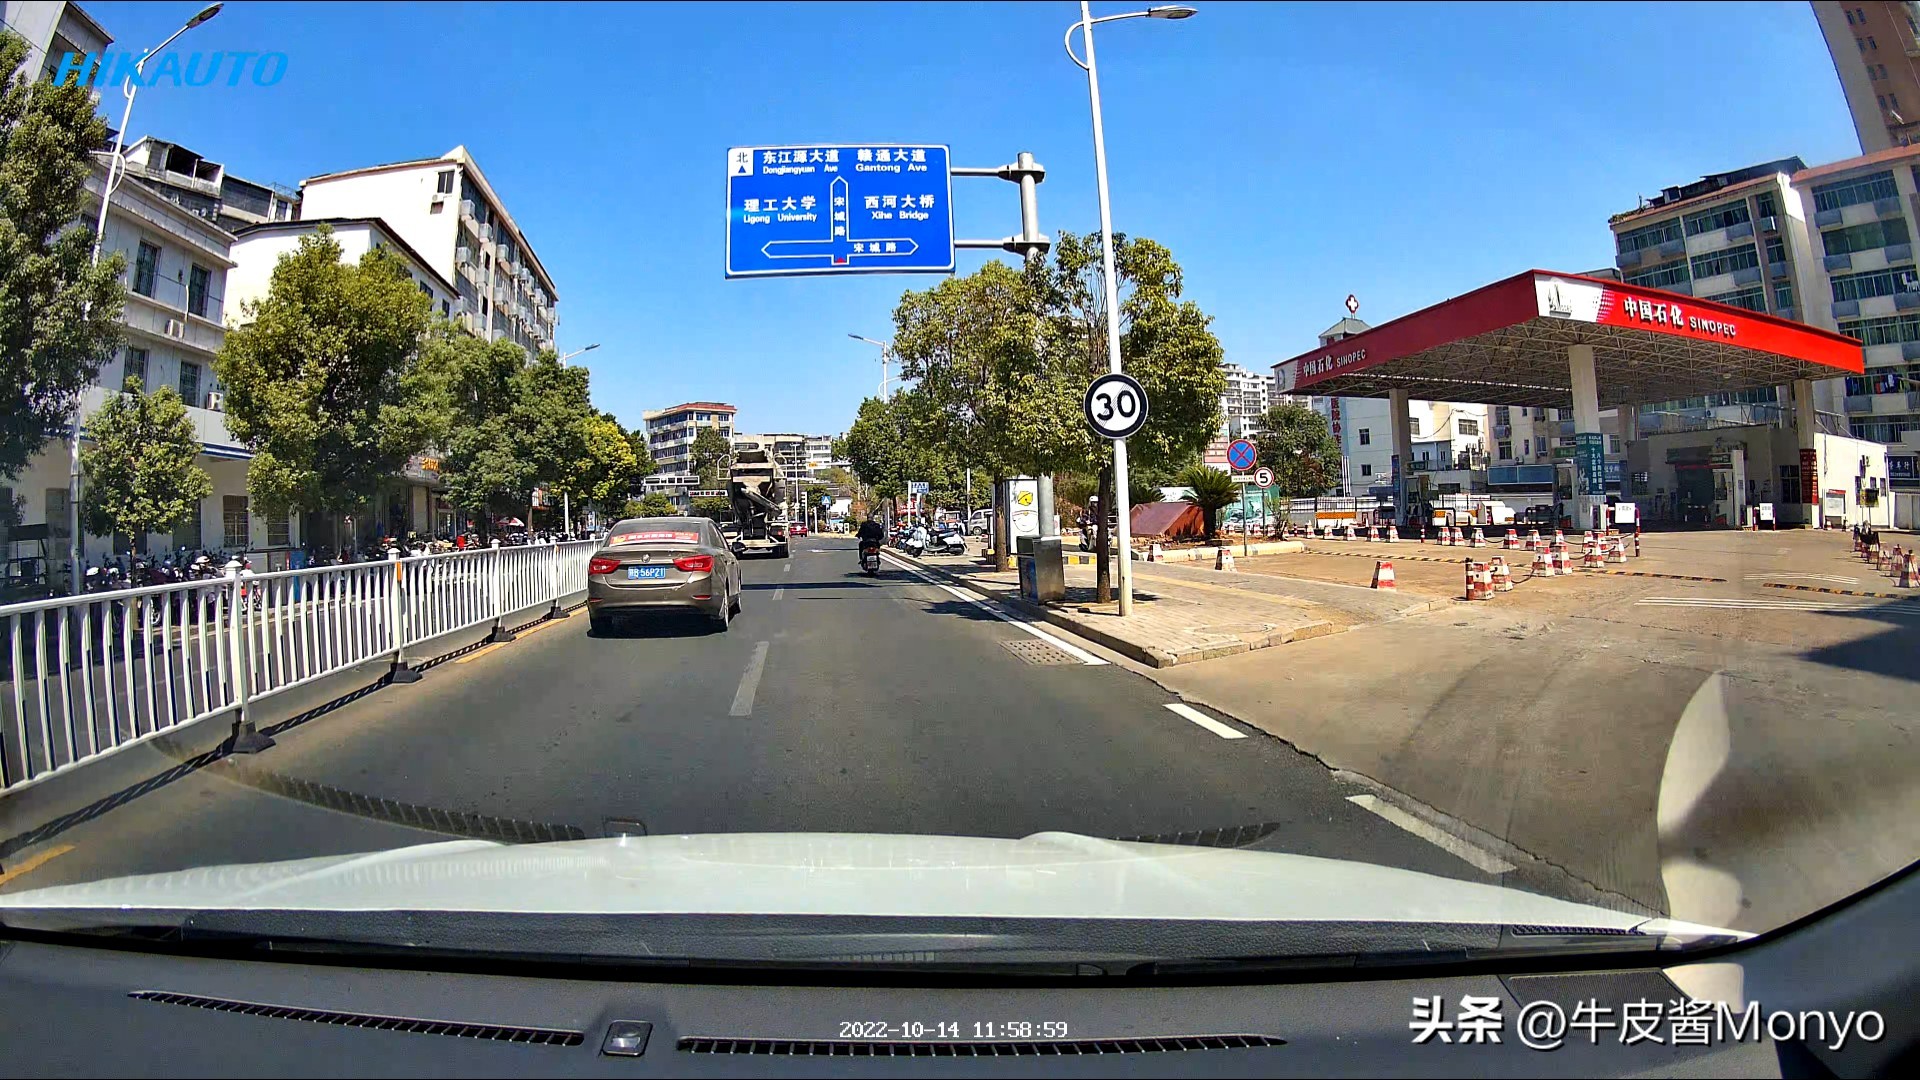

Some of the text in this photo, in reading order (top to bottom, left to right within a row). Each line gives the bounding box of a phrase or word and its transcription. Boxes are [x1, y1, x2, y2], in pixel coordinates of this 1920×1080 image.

[736, 151, 748, 163] 北
[762, 150, 840, 165] 东江源大道
[857, 149, 926, 163] 赣通大道
[824, 164, 838, 173] Ave
[855, 163, 928, 173] Gantong Ave
[743, 196, 816, 213] 理工大学
[864, 194, 935, 210] 西河大桥
[743, 211, 817, 224] Ligong University
[833, 197, 846, 237] 宋城路
[871, 210, 929, 221] Xihe Bridge
[1623, 296, 1685, 327] 中国石化
[1689, 315, 1737, 337] SINOPEC
[1302, 353, 1333, 378] 中国石化
[1336, 348, 1367, 368] SINOPEC
[1096, 390, 1136, 420] 30
[1259, 472, 1269, 484] 5
